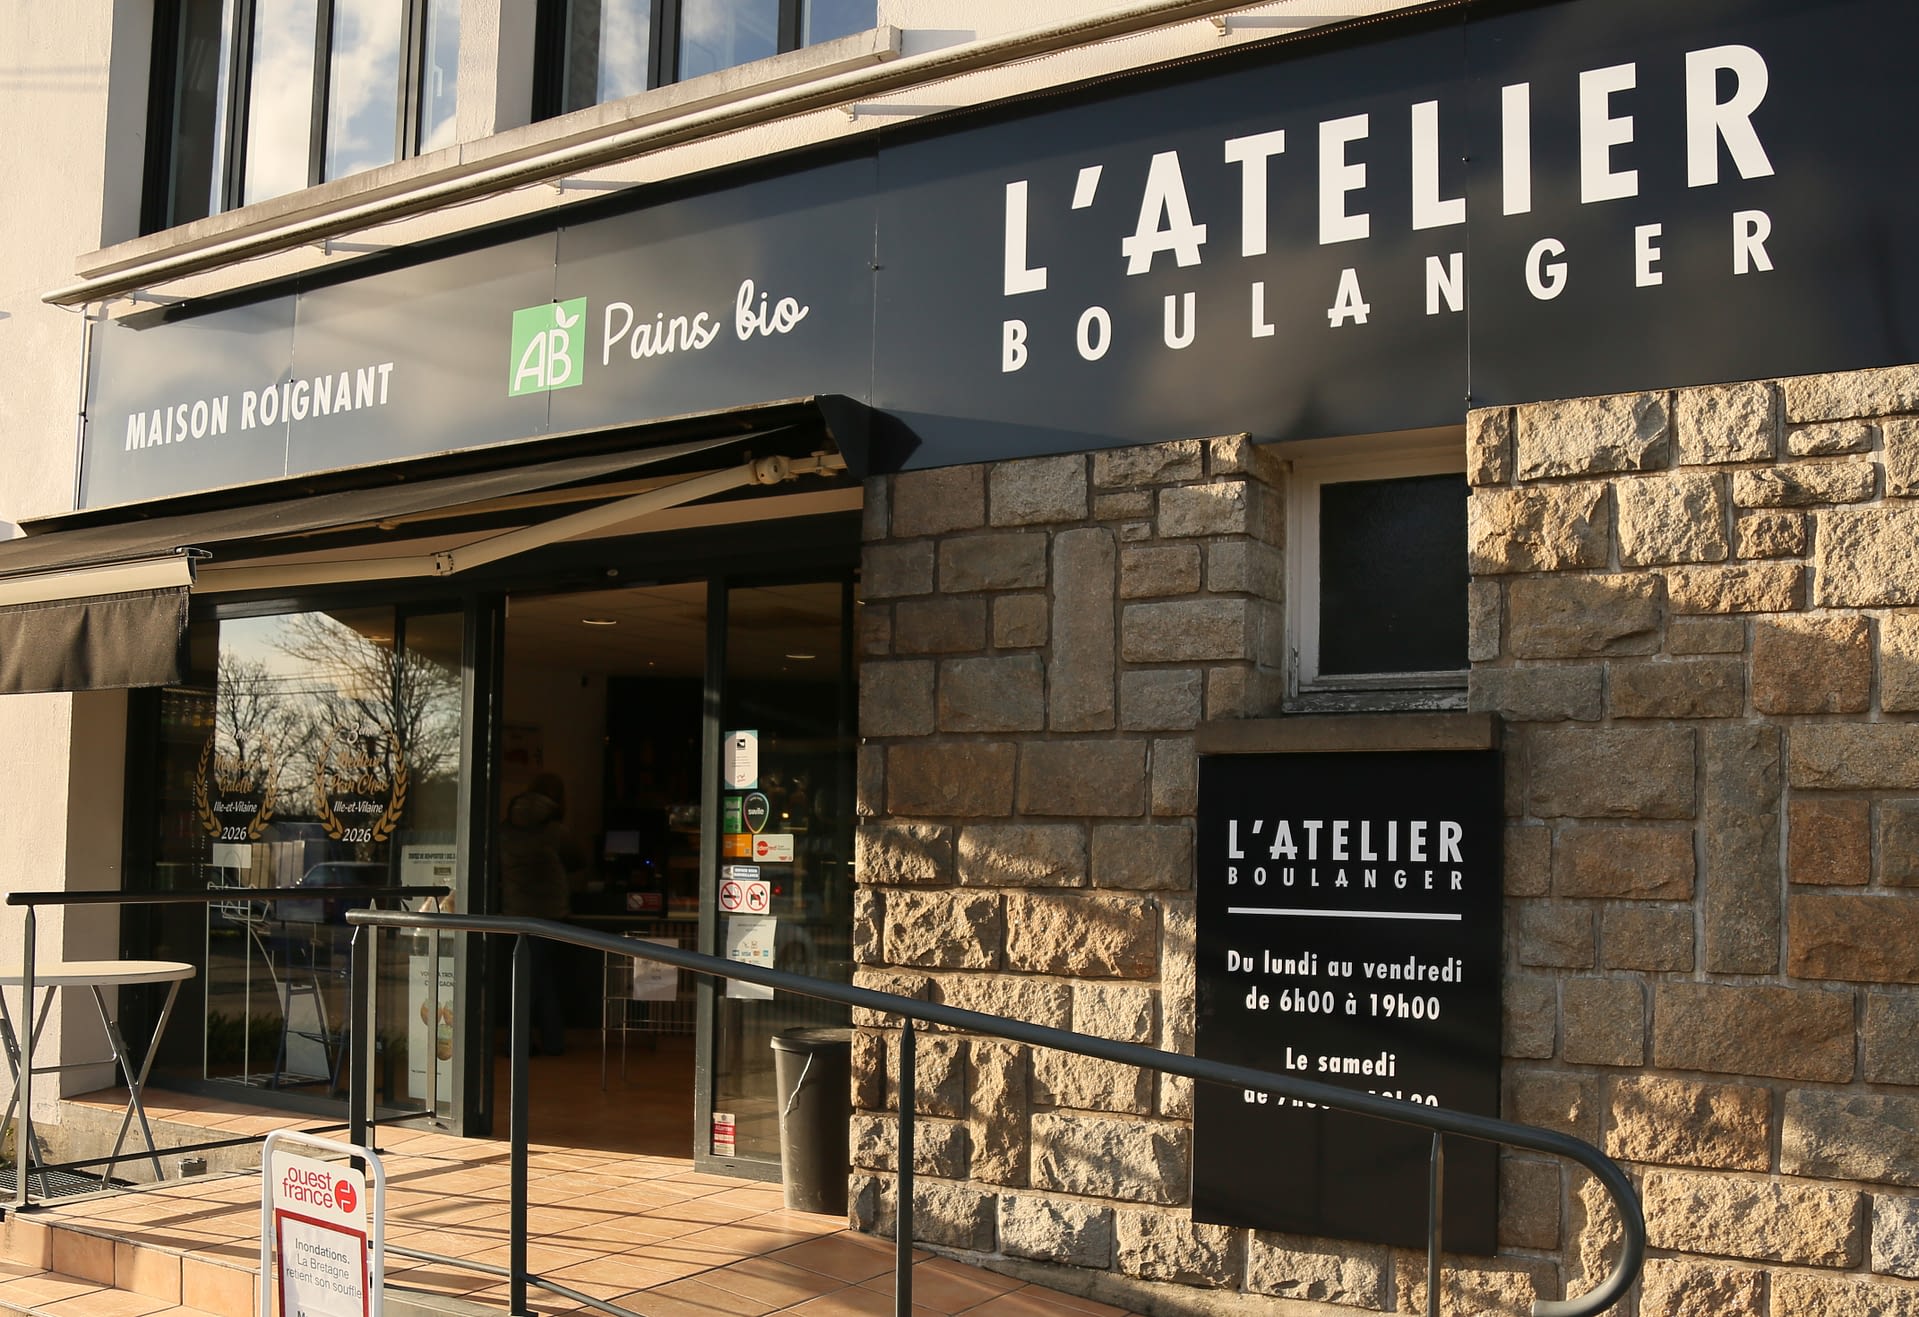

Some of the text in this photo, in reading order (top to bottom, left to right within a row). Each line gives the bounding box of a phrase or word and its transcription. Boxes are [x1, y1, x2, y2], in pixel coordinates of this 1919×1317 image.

[1003, 44, 1775, 296] L'ATELIER
[1002, 209, 1774, 373] BOULANGER
[602, 278, 810, 366] Pains bio
[513, 328, 572, 392] AB
[125, 362, 394, 451] MAISON ROIGNANT
[213, 800, 258, 813] Ille-et-Vilaine
[333, 800, 384, 813] Ille-et-Vilaine
[221, 826, 247, 841] 2026
[342, 827, 372, 843] 2026
[1229, 820, 1463, 863] L'ATELIER
[1228, 867, 1462, 890] BOULANGER
[1228, 950, 1462, 983] Du lundi au vendredi
[1246, 986, 1440, 1020] de 6h00 à 19h00
[1286, 1047, 1396, 1077] Le samedi
[282, 1177, 333, 1209] france
[288, 1167, 332, 1192] ouest
[295, 1238, 350, 1264] Inondations.
[297, 1253, 350, 1279] La Bretagne
[286, 1268, 362, 1299] retient son souffle
